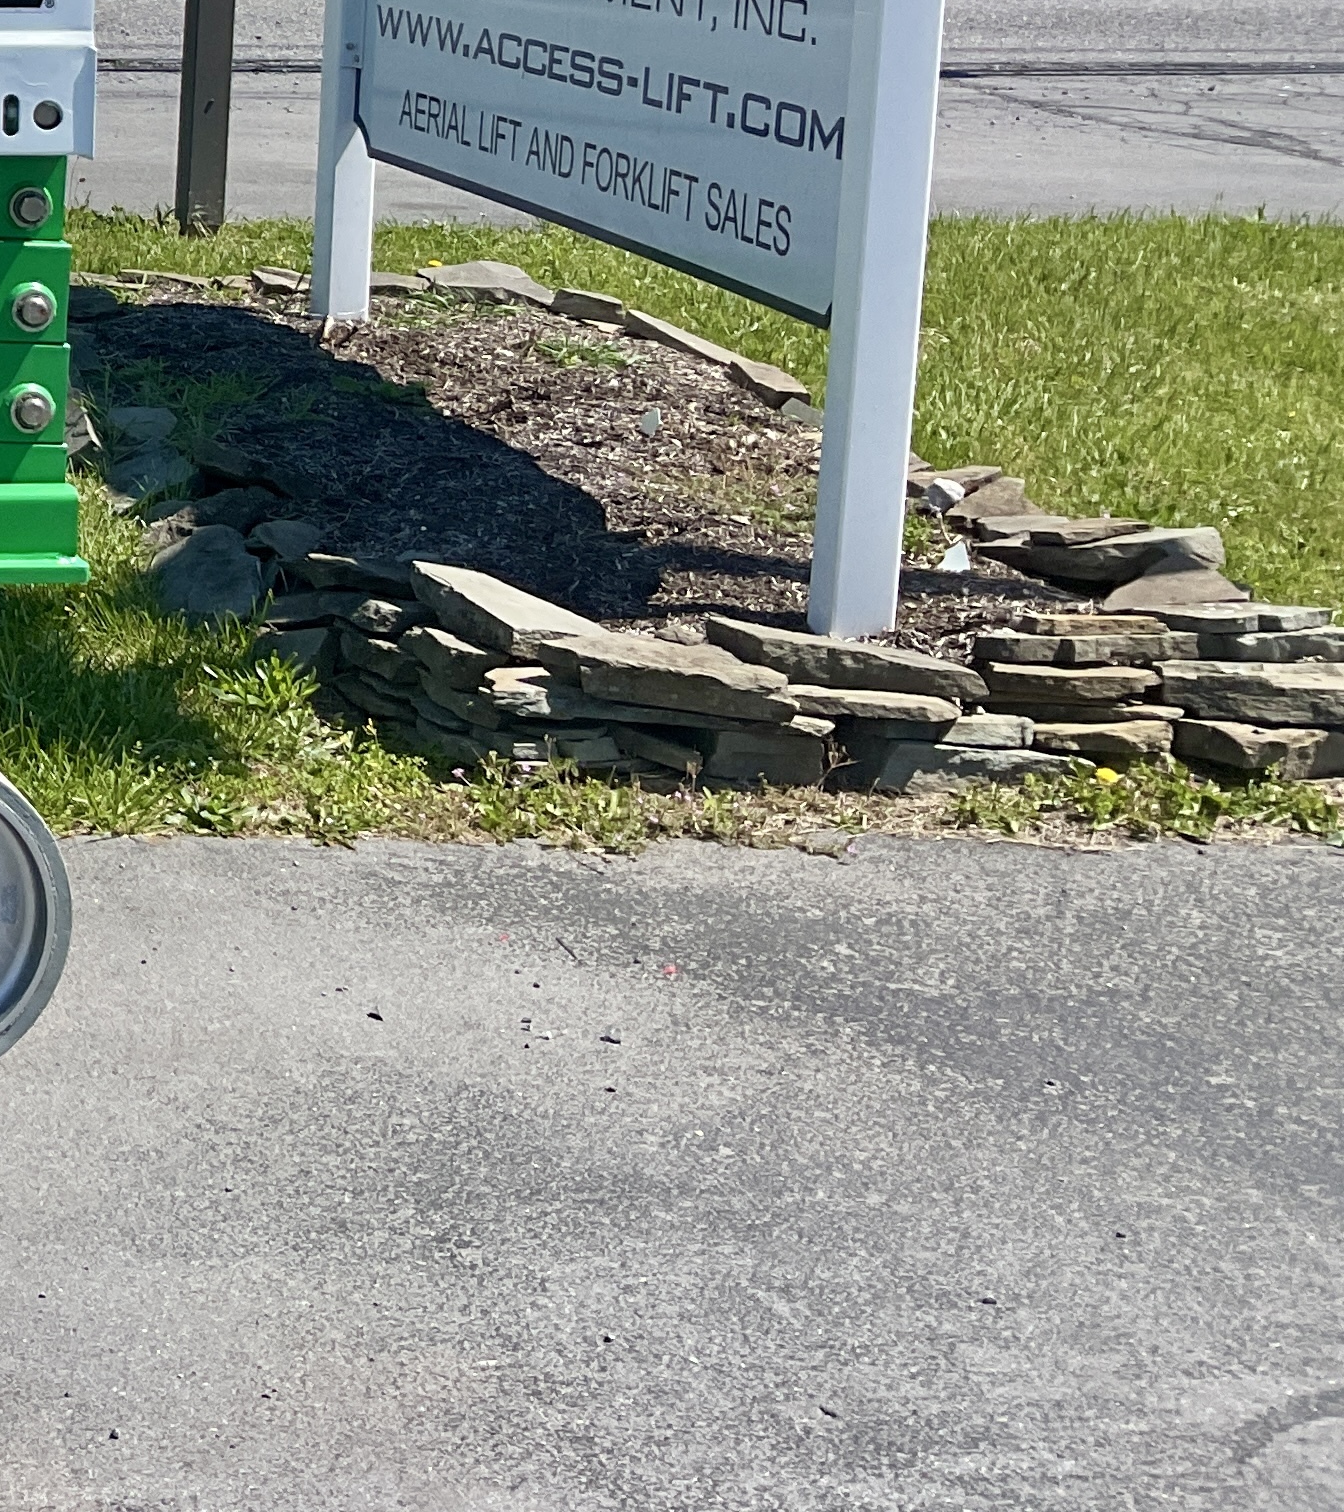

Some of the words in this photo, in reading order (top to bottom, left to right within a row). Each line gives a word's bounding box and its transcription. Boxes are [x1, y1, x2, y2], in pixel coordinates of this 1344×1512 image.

[376, 4, 846, 161] WWW.ACCESS-LIFT.COM
[398, 89, 472, 150] AERIAL
[478, 113, 523, 162] LIFT
[525, 127, 574, 179] AND
[581, 143, 699, 231] FORKLIFT
[705, 181, 792, 257] SALES
